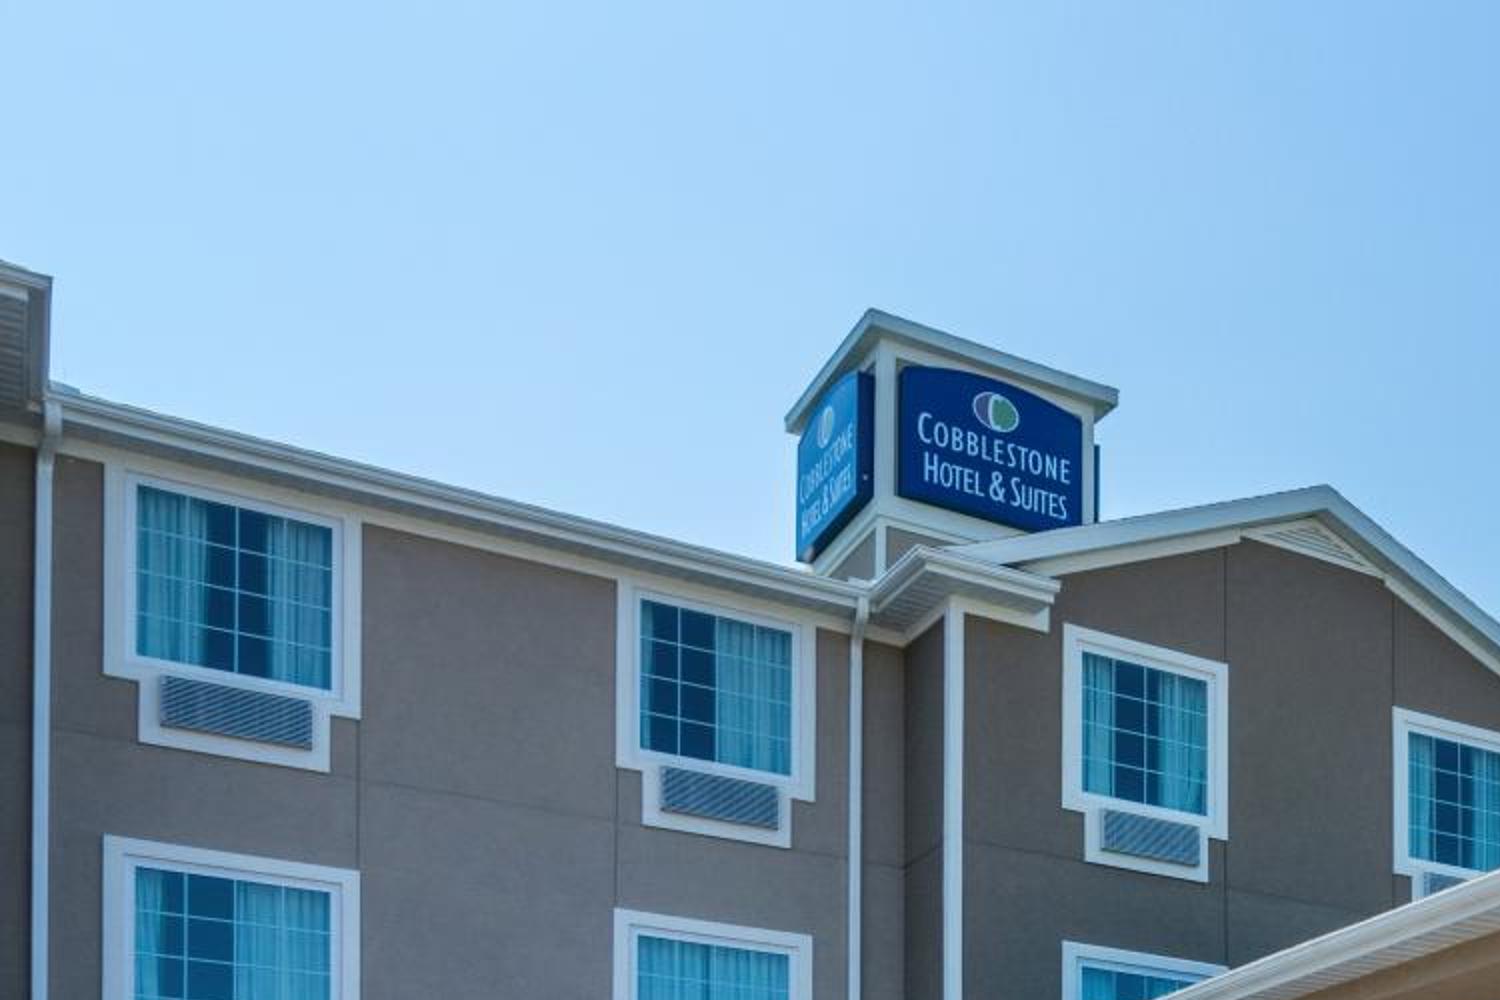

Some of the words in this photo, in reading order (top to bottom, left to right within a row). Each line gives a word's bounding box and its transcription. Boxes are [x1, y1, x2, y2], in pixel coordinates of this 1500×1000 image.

[917, 412, 1071, 485] COBBLESTONE
[924, 451, 985, 496] HOTEL
[989, 471, 1006, 504] &
[1010, 476, 1067, 520] SUITES
